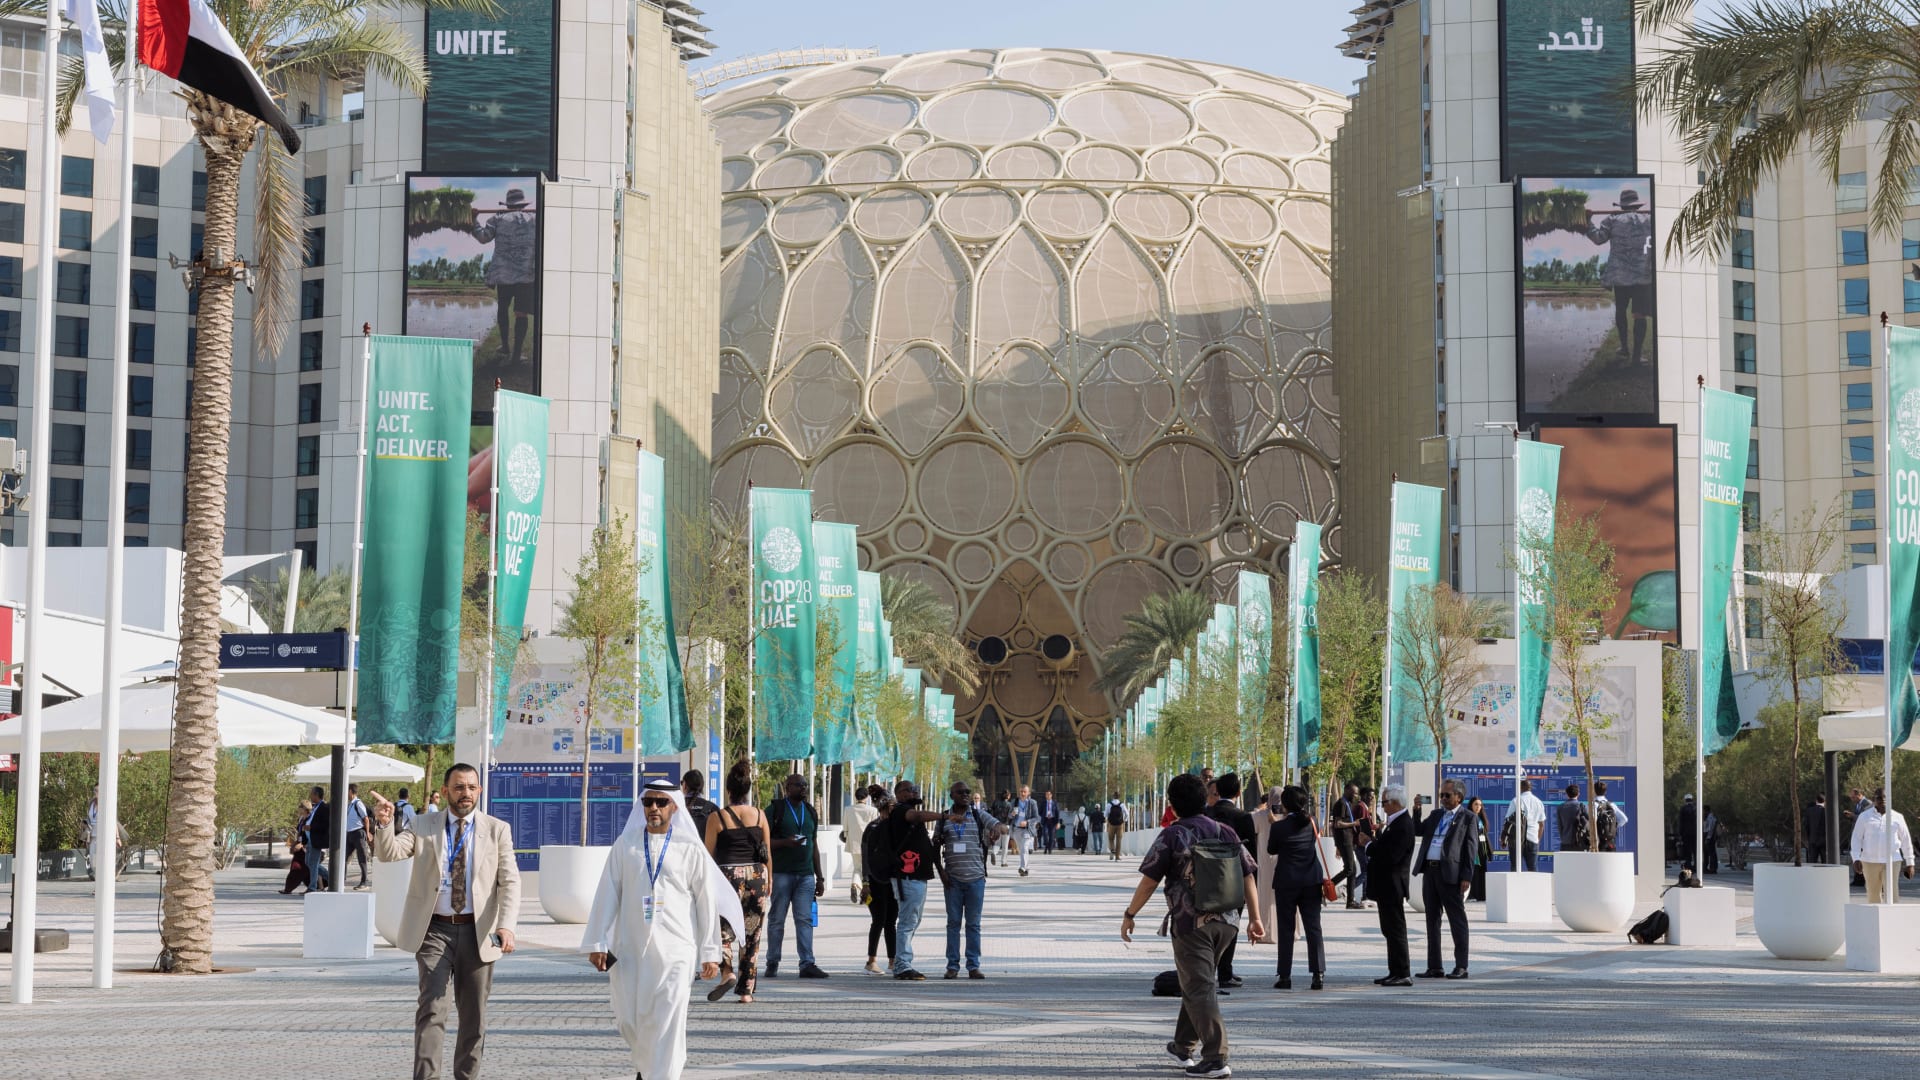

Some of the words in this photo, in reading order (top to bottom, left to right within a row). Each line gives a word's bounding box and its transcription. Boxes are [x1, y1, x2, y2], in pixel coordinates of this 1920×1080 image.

[436, 30, 514, 55] UNITE.
[378, 390, 434, 411] UNITE.
[376, 414, 414, 433] ACT.
[376, 438, 453, 459] DELIVER.
[1704, 439, 1732, 460] UNITE.
[1704, 460, 1721, 479] ACT.
[1704, 481, 1741, 504] DELIVER.
[1896, 469, 1920, 506] CO
[506, 510, 542, 546] COP28
[505, 543, 525, 576] UAE
[819, 555, 842, 569] UNITE.
[1395, 554, 1431, 570] DELIVER.
[819, 569, 834, 582] ACT.
[761, 579, 812, 604] COP28
[820, 583, 856, 597] DELIVER.
[761, 604, 797, 629] UAE
